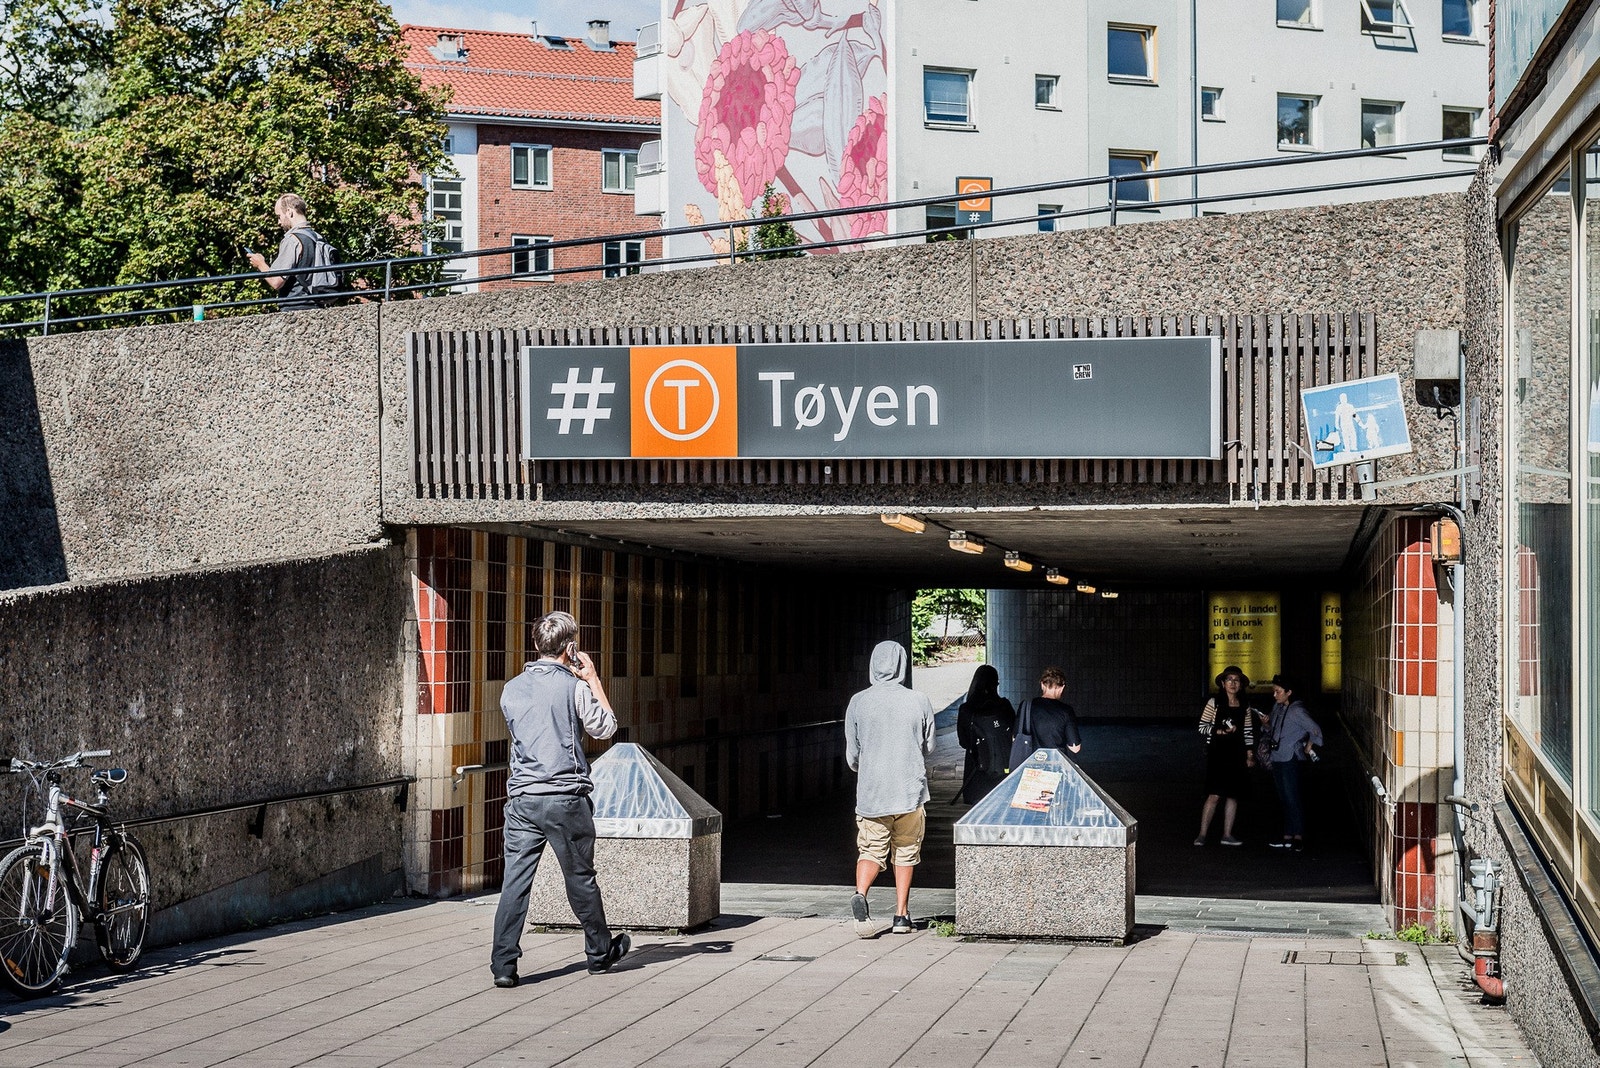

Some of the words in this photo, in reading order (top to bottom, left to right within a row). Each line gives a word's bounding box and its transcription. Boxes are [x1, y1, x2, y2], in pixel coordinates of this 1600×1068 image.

[1075, 371, 1090, 379] CREW
[758, 371, 939, 442] Tøyen
[1213, 605, 1229, 613] Fra
[1230, 607, 1241, 615] ny
[1248, 604, 1278, 613] landet
[1325, 605, 1340, 613] Fra
[1213, 619, 1221, 627] til
[1223, 619, 1230, 627] 6
[1236, 618, 1263, 627] norsk
[1325, 619, 1333, 627] til
[1213, 632, 1225, 642] på
[1227, 632, 1240, 640] ett
[1242, 632, 1254, 640] år.
[1325, 632, 1337, 642] på
